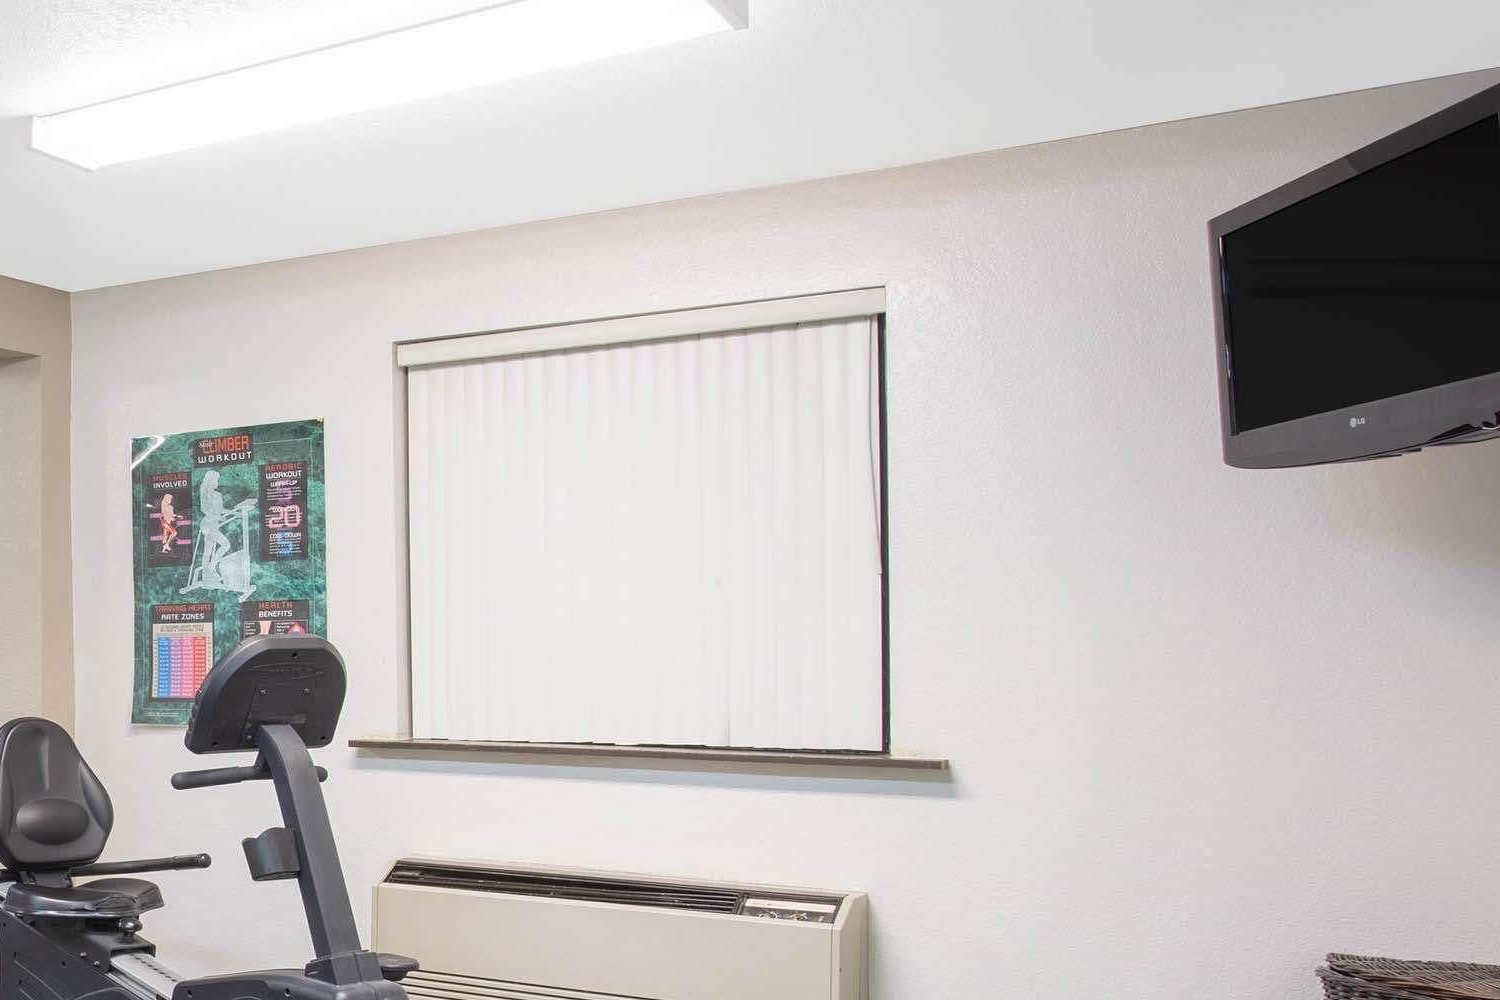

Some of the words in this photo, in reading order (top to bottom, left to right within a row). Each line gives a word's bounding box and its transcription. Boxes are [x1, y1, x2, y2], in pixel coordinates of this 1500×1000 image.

[197, 451, 252, 463] WORKOUT
[265, 470, 301, 479] WORKOUT
[153, 480, 188, 488] INVOLVED
[268, 504, 301, 528] 20
[259, 610, 293, 618] BENEFITS
